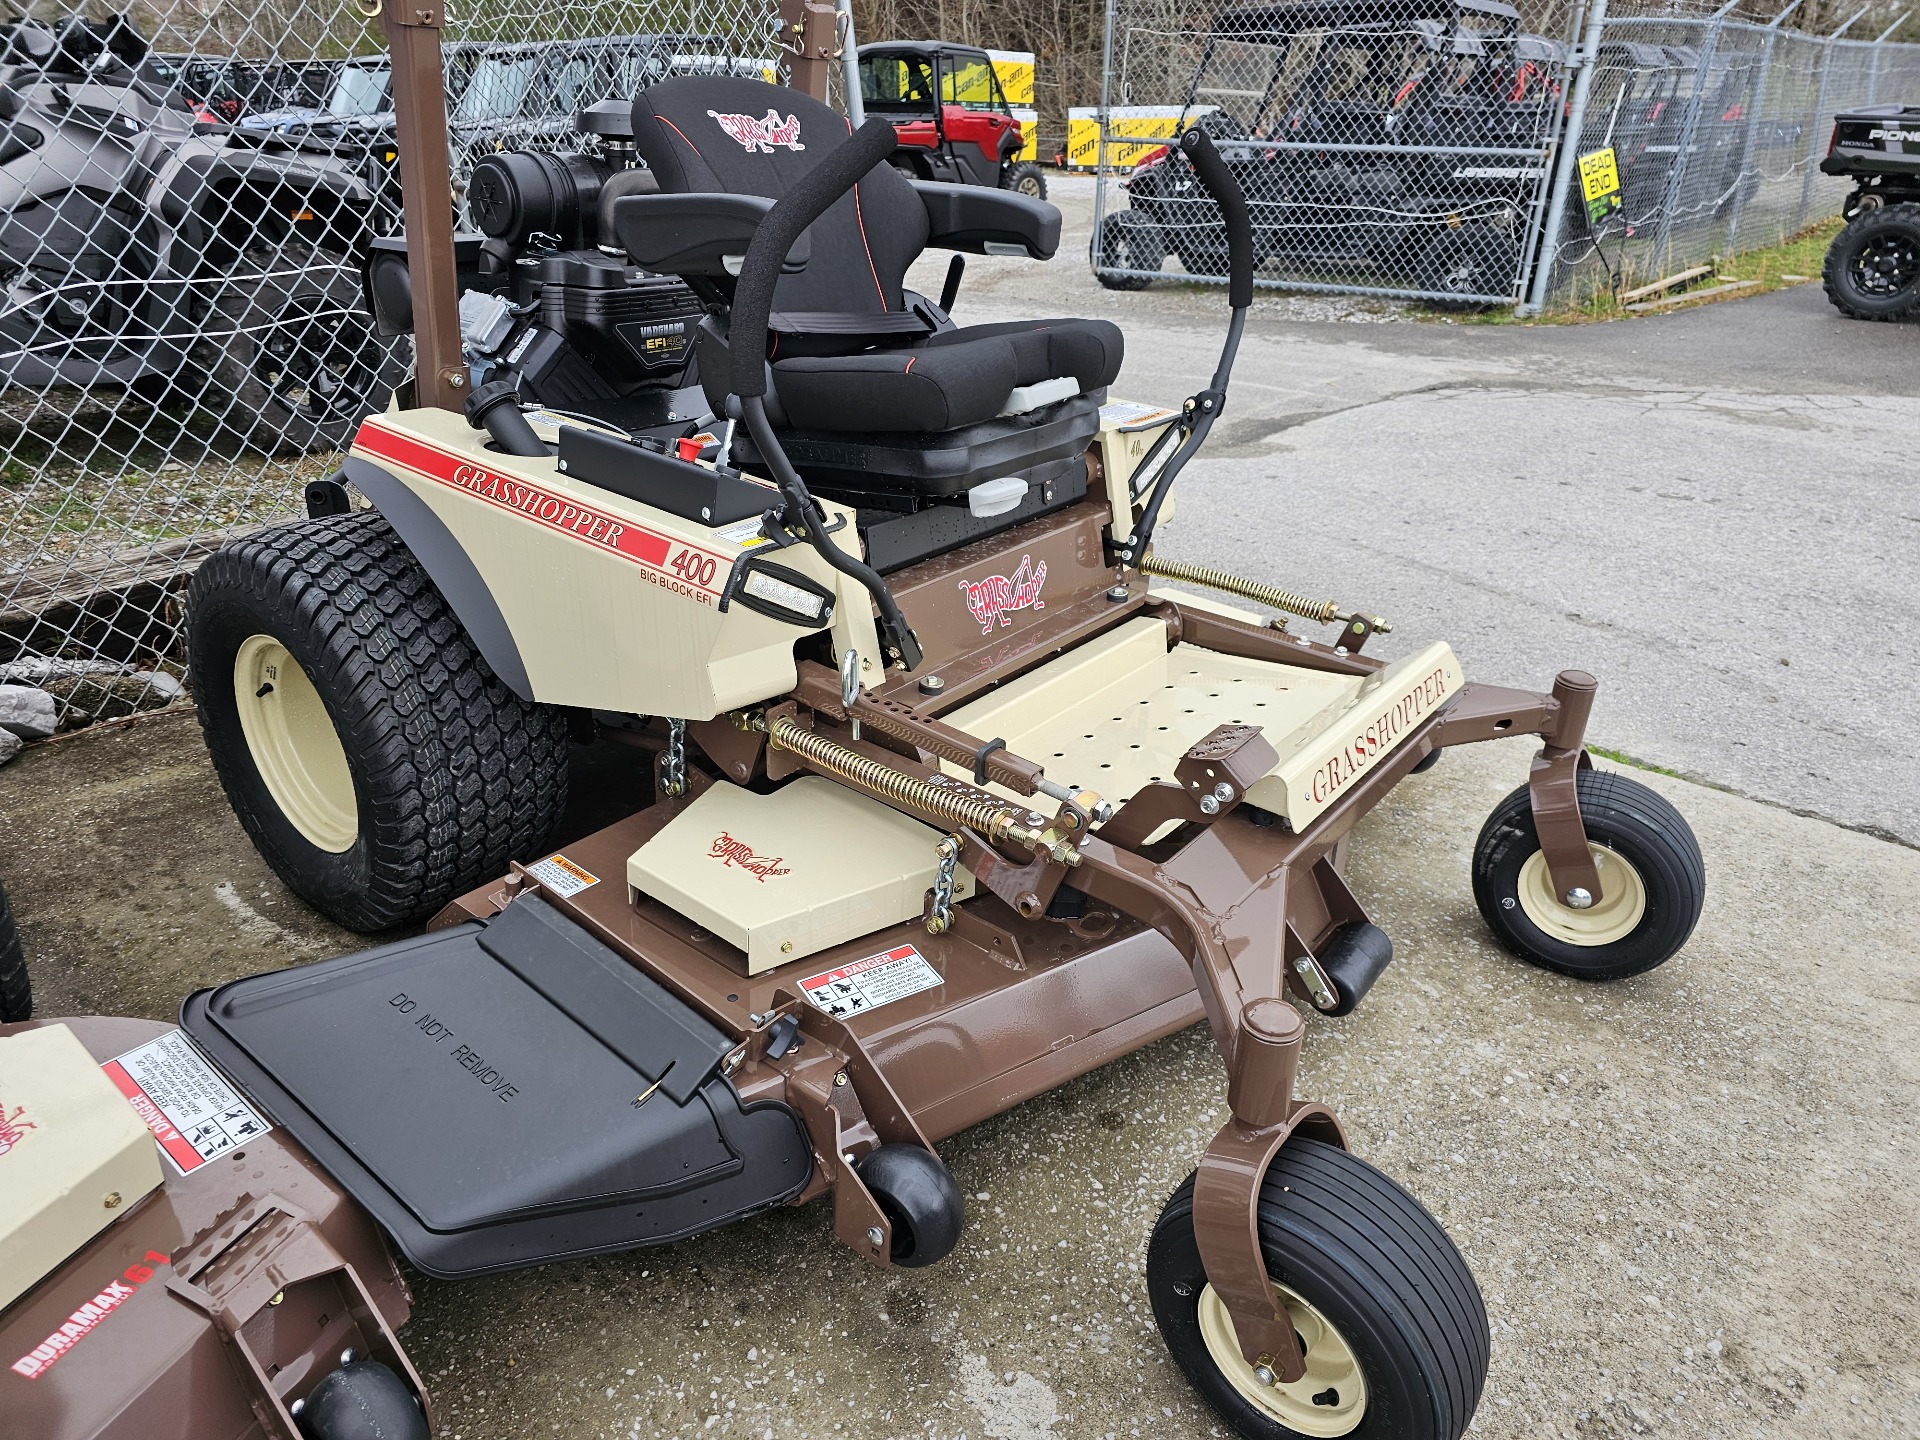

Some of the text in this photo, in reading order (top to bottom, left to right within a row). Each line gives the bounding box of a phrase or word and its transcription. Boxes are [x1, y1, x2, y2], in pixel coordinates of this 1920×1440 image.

[1841, 140, 1875, 148] HONDA
[1583, 153, 1611, 176] DEAD
[1175, 180, 1193, 191] L7
[1589, 173, 1611, 195] END
[640, 322, 684, 338] VANGUARD
[453, 465, 624, 547] GRASSHOPPER
[671, 549, 717, 586] 400
[640, 568, 712, 607] BIG BLOCK EFI
[1312, 668, 1446, 804] GRASSHOPPER
[841, 954, 893, 977] DANGER
[860, 957, 913, 978] KEEP AWAY!
[179, 1051, 190, 1059] IN
[388, 992, 520, 1103] DO NOT REMOVE
[154, 1038, 226, 1111] NEVER OPERATE WITHOUT DISCHARGE
[183, 1056, 204, 1074] SHIELDS
[133, 1058, 192, 1118] TO AVOID SERIOUS INJURY OR
[141, 1052, 203, 1115] DEATH FROM THROWN OBJECTS
[177, 1077, 196, 1093] BLADE
[197, 1071, 212, 1083] SIDE
[205, 1080, 219, 1090] OR
[135, 1075, 171, 1109] KEEP AWAY!
[189, 1090, 202, 1100] OR
[212, 1087, 231, 1103] CHUTE
[129, 1093, 170, 1134] DANGER
[11, 1249, 171, 1376] DURAMAX 61
[30, 1288, 134, 1379] PROFESSIONAL CUT
